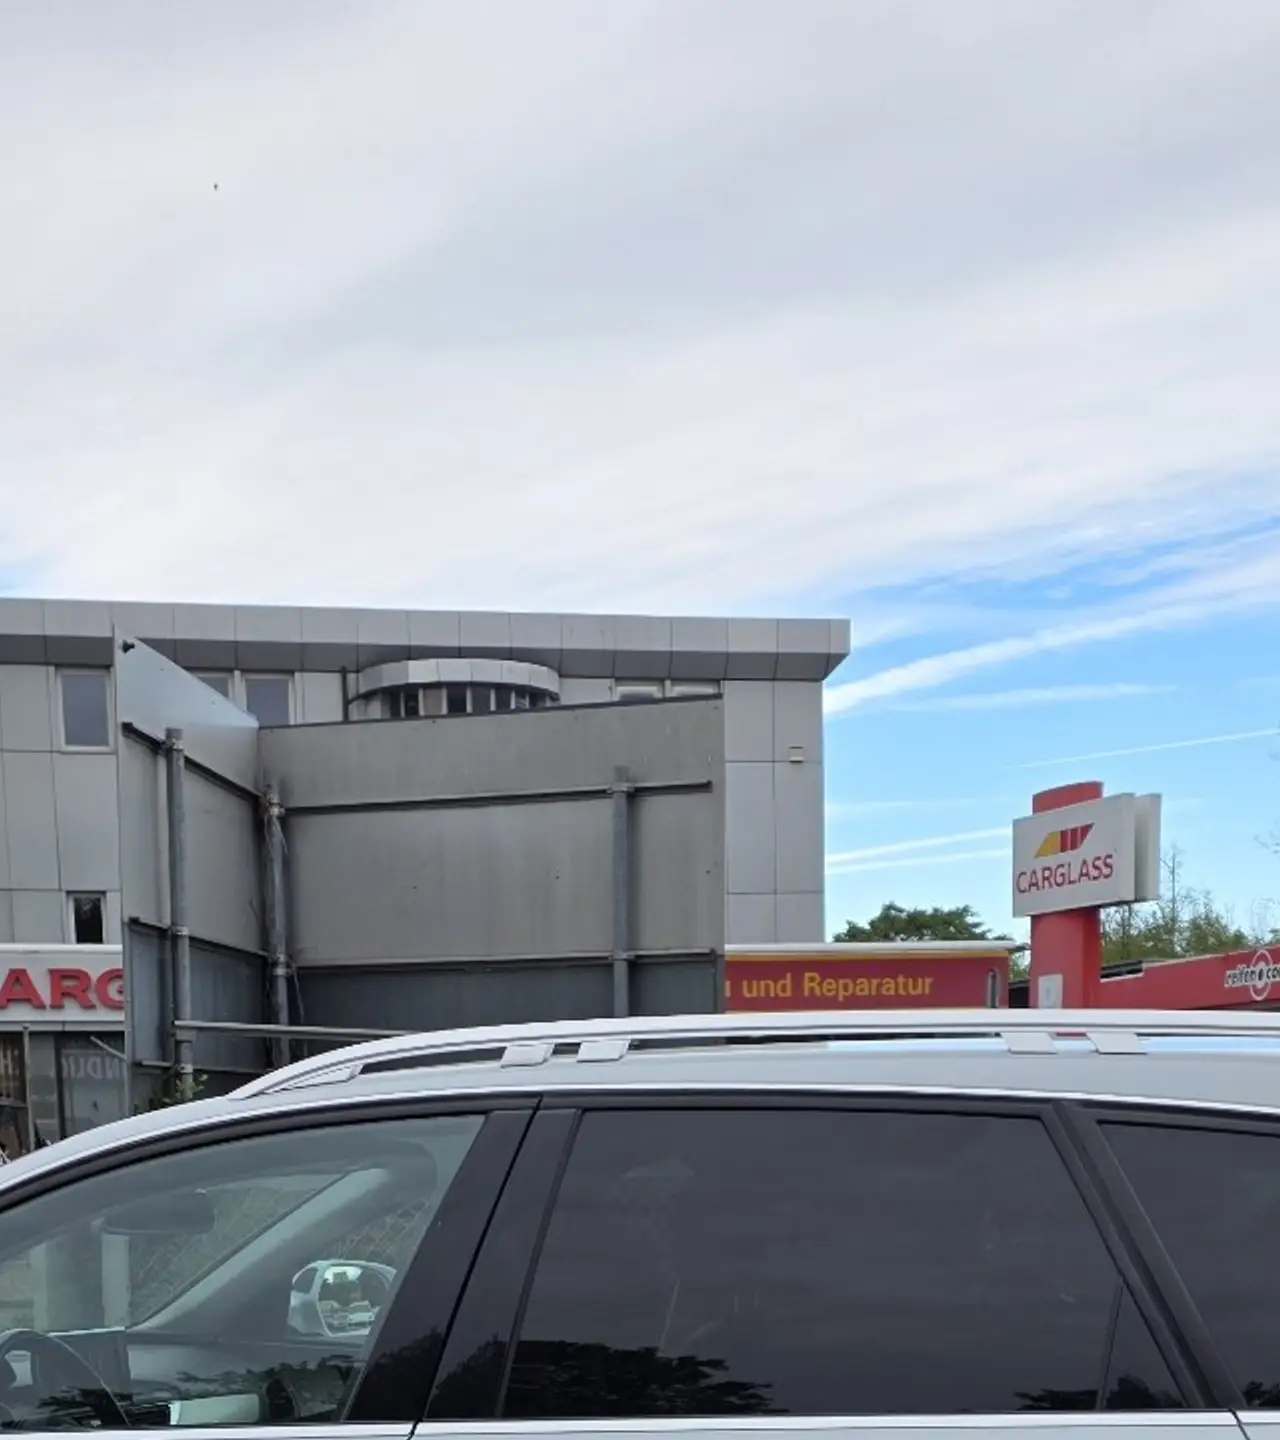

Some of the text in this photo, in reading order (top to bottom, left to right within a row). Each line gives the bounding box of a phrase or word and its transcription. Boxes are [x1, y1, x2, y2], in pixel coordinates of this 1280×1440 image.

[1016, 853, 1114, 894] CARGLASS
[742, 972, 792, 998] und
[803, 972, 934, 1002] Reparatur
